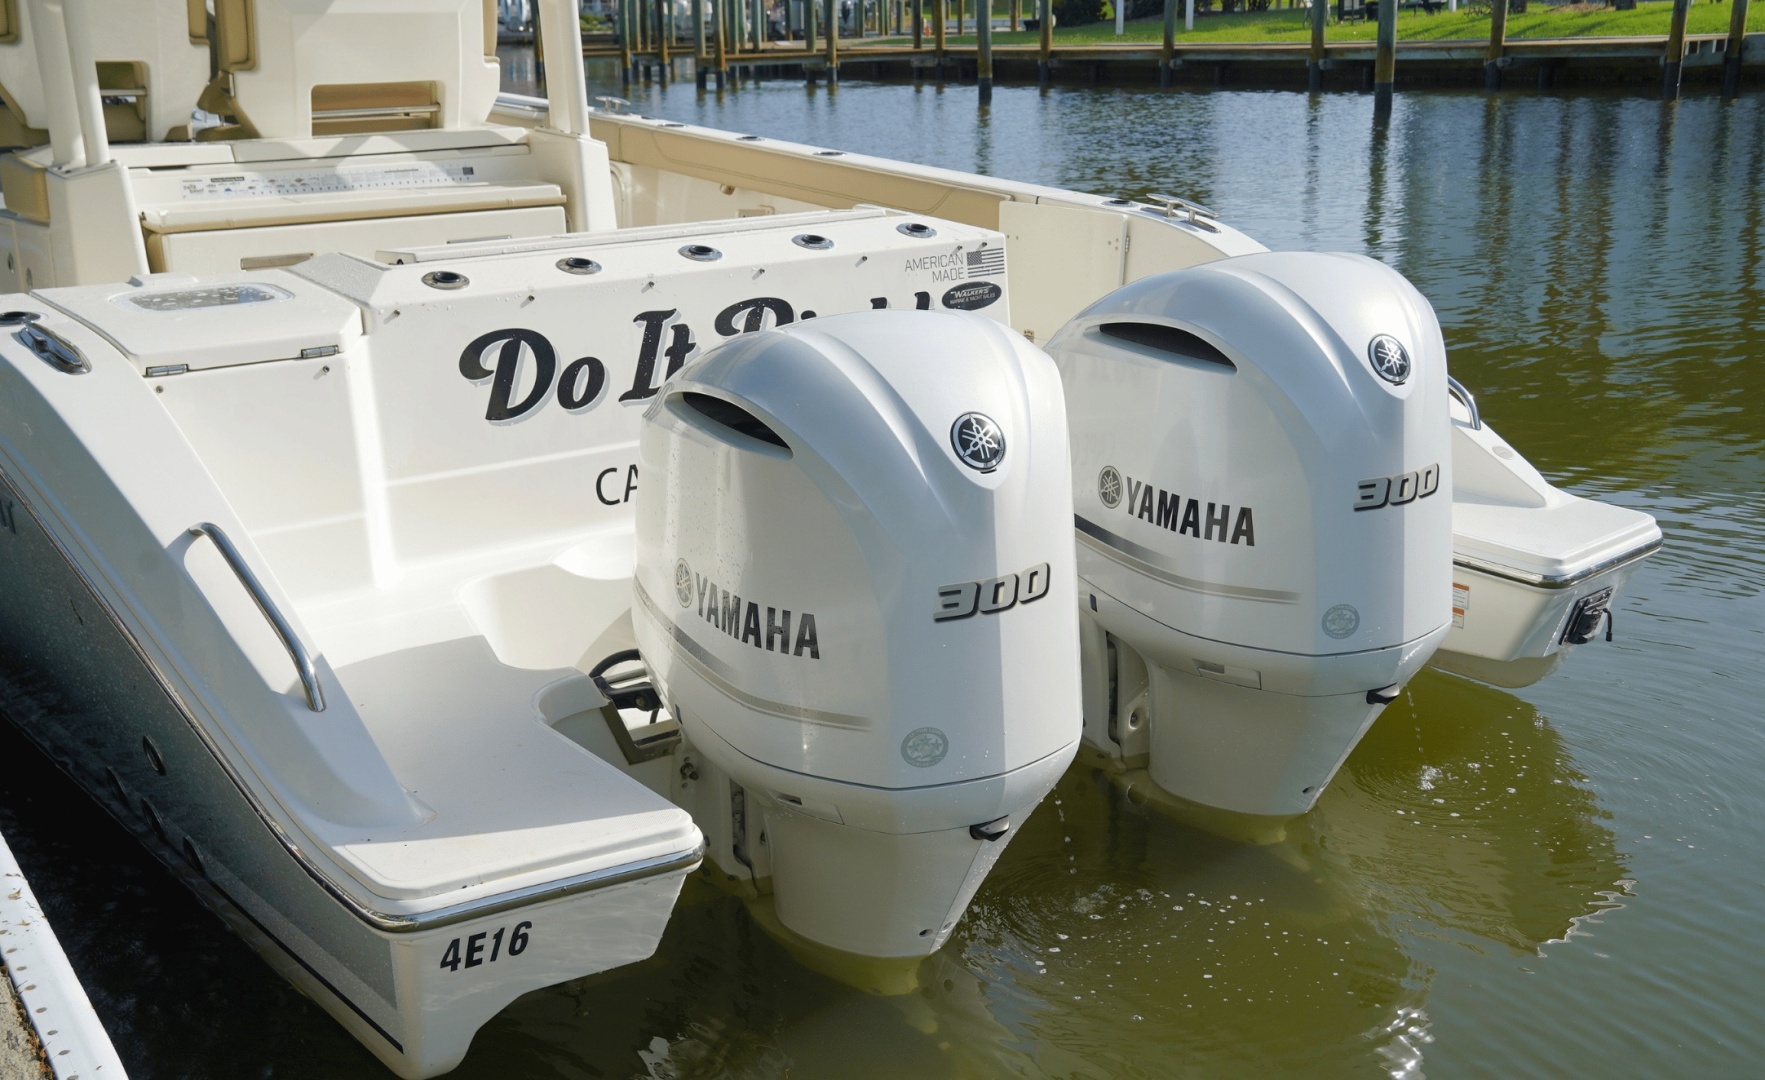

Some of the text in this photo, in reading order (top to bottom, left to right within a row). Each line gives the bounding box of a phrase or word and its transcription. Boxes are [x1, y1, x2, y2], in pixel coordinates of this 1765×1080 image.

[905, 252, 964, 272] AMERICAN
[932, 267, 965, 283] MADE
[459, 328, 607, 422] Do
[618, 308, 698, 403] It
[1126, 476, 1255, 547] YAMAHA
[1354, 463, 1440, 512] 300
[695, 572, 820, 660] YAMAHA
[933, 562, 1050, 623] 300
[440, 921, 532, 972] 4E16
